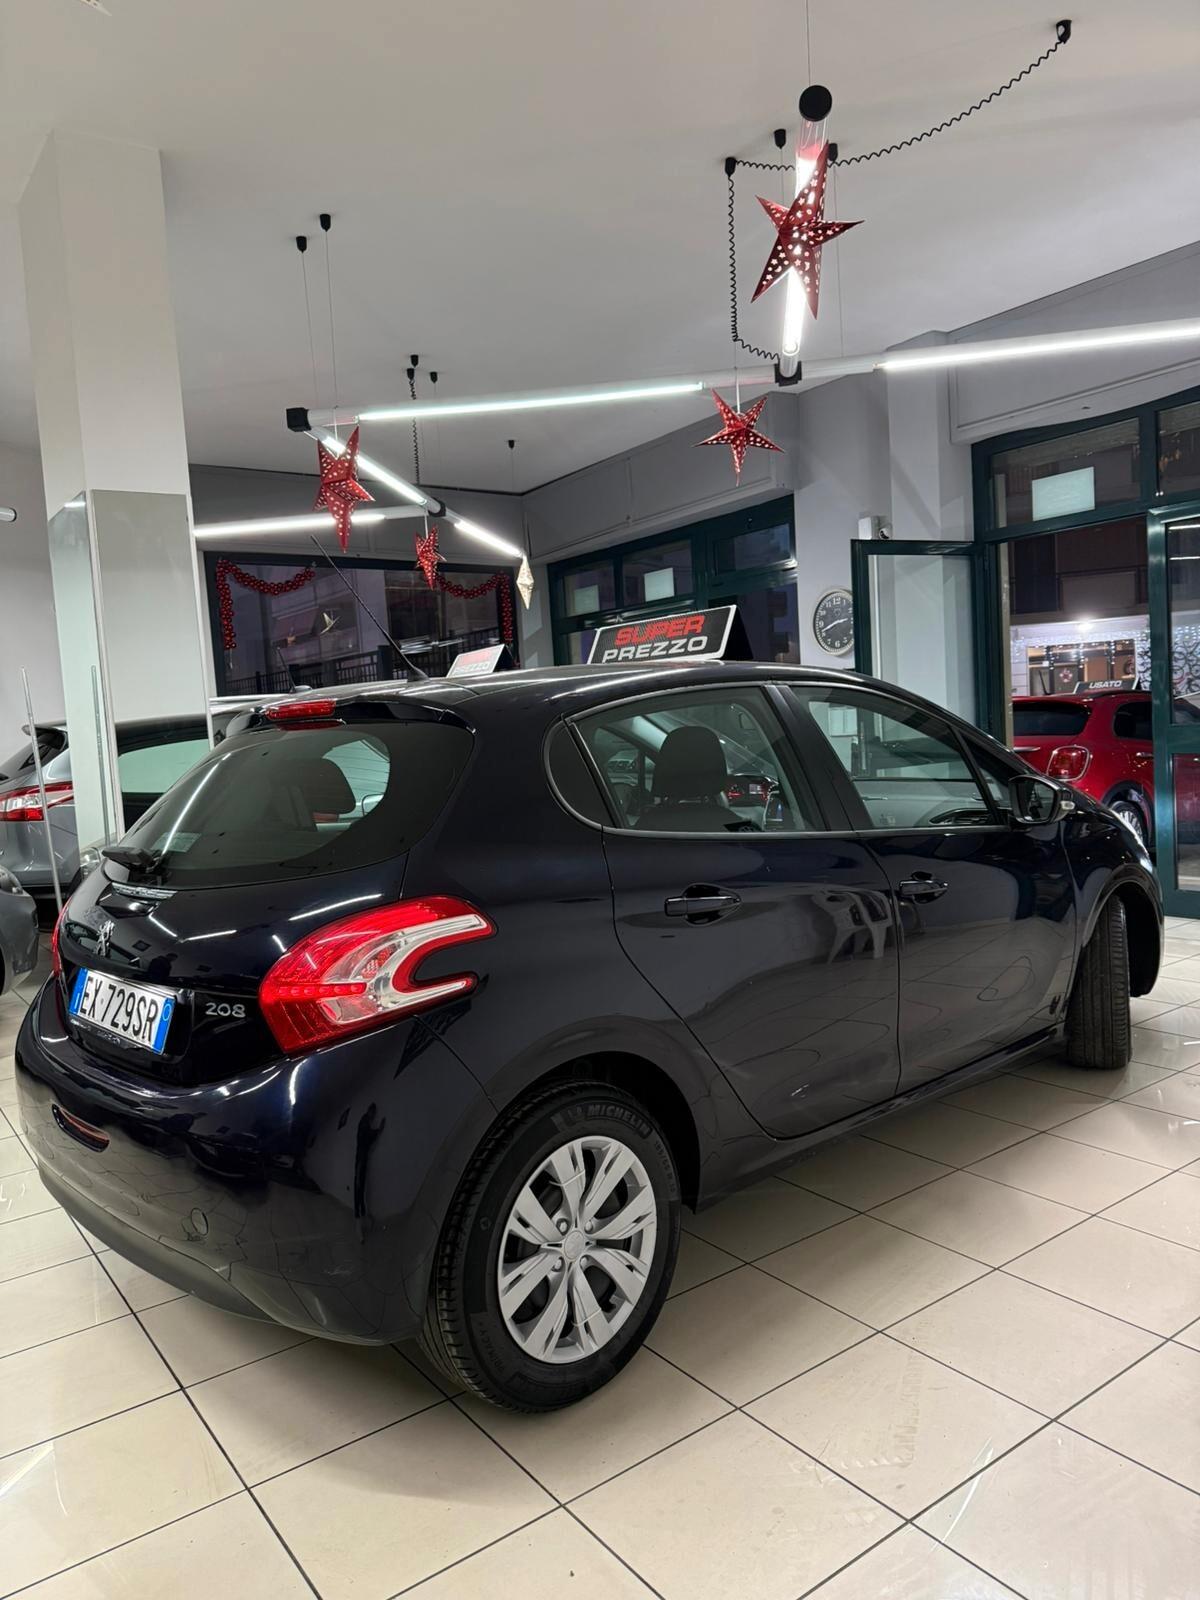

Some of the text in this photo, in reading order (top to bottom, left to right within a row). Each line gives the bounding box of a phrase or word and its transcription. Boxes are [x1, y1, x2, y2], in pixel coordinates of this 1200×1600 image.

[614, 615, 705, 646] SUPER
[602, 636, 708, 663] PREZZO
[1088, 680, 1122, 689] USATO
[205, 1002, 246, 1018] 208
[588, 1103, 651, 1134] MICHELIN
